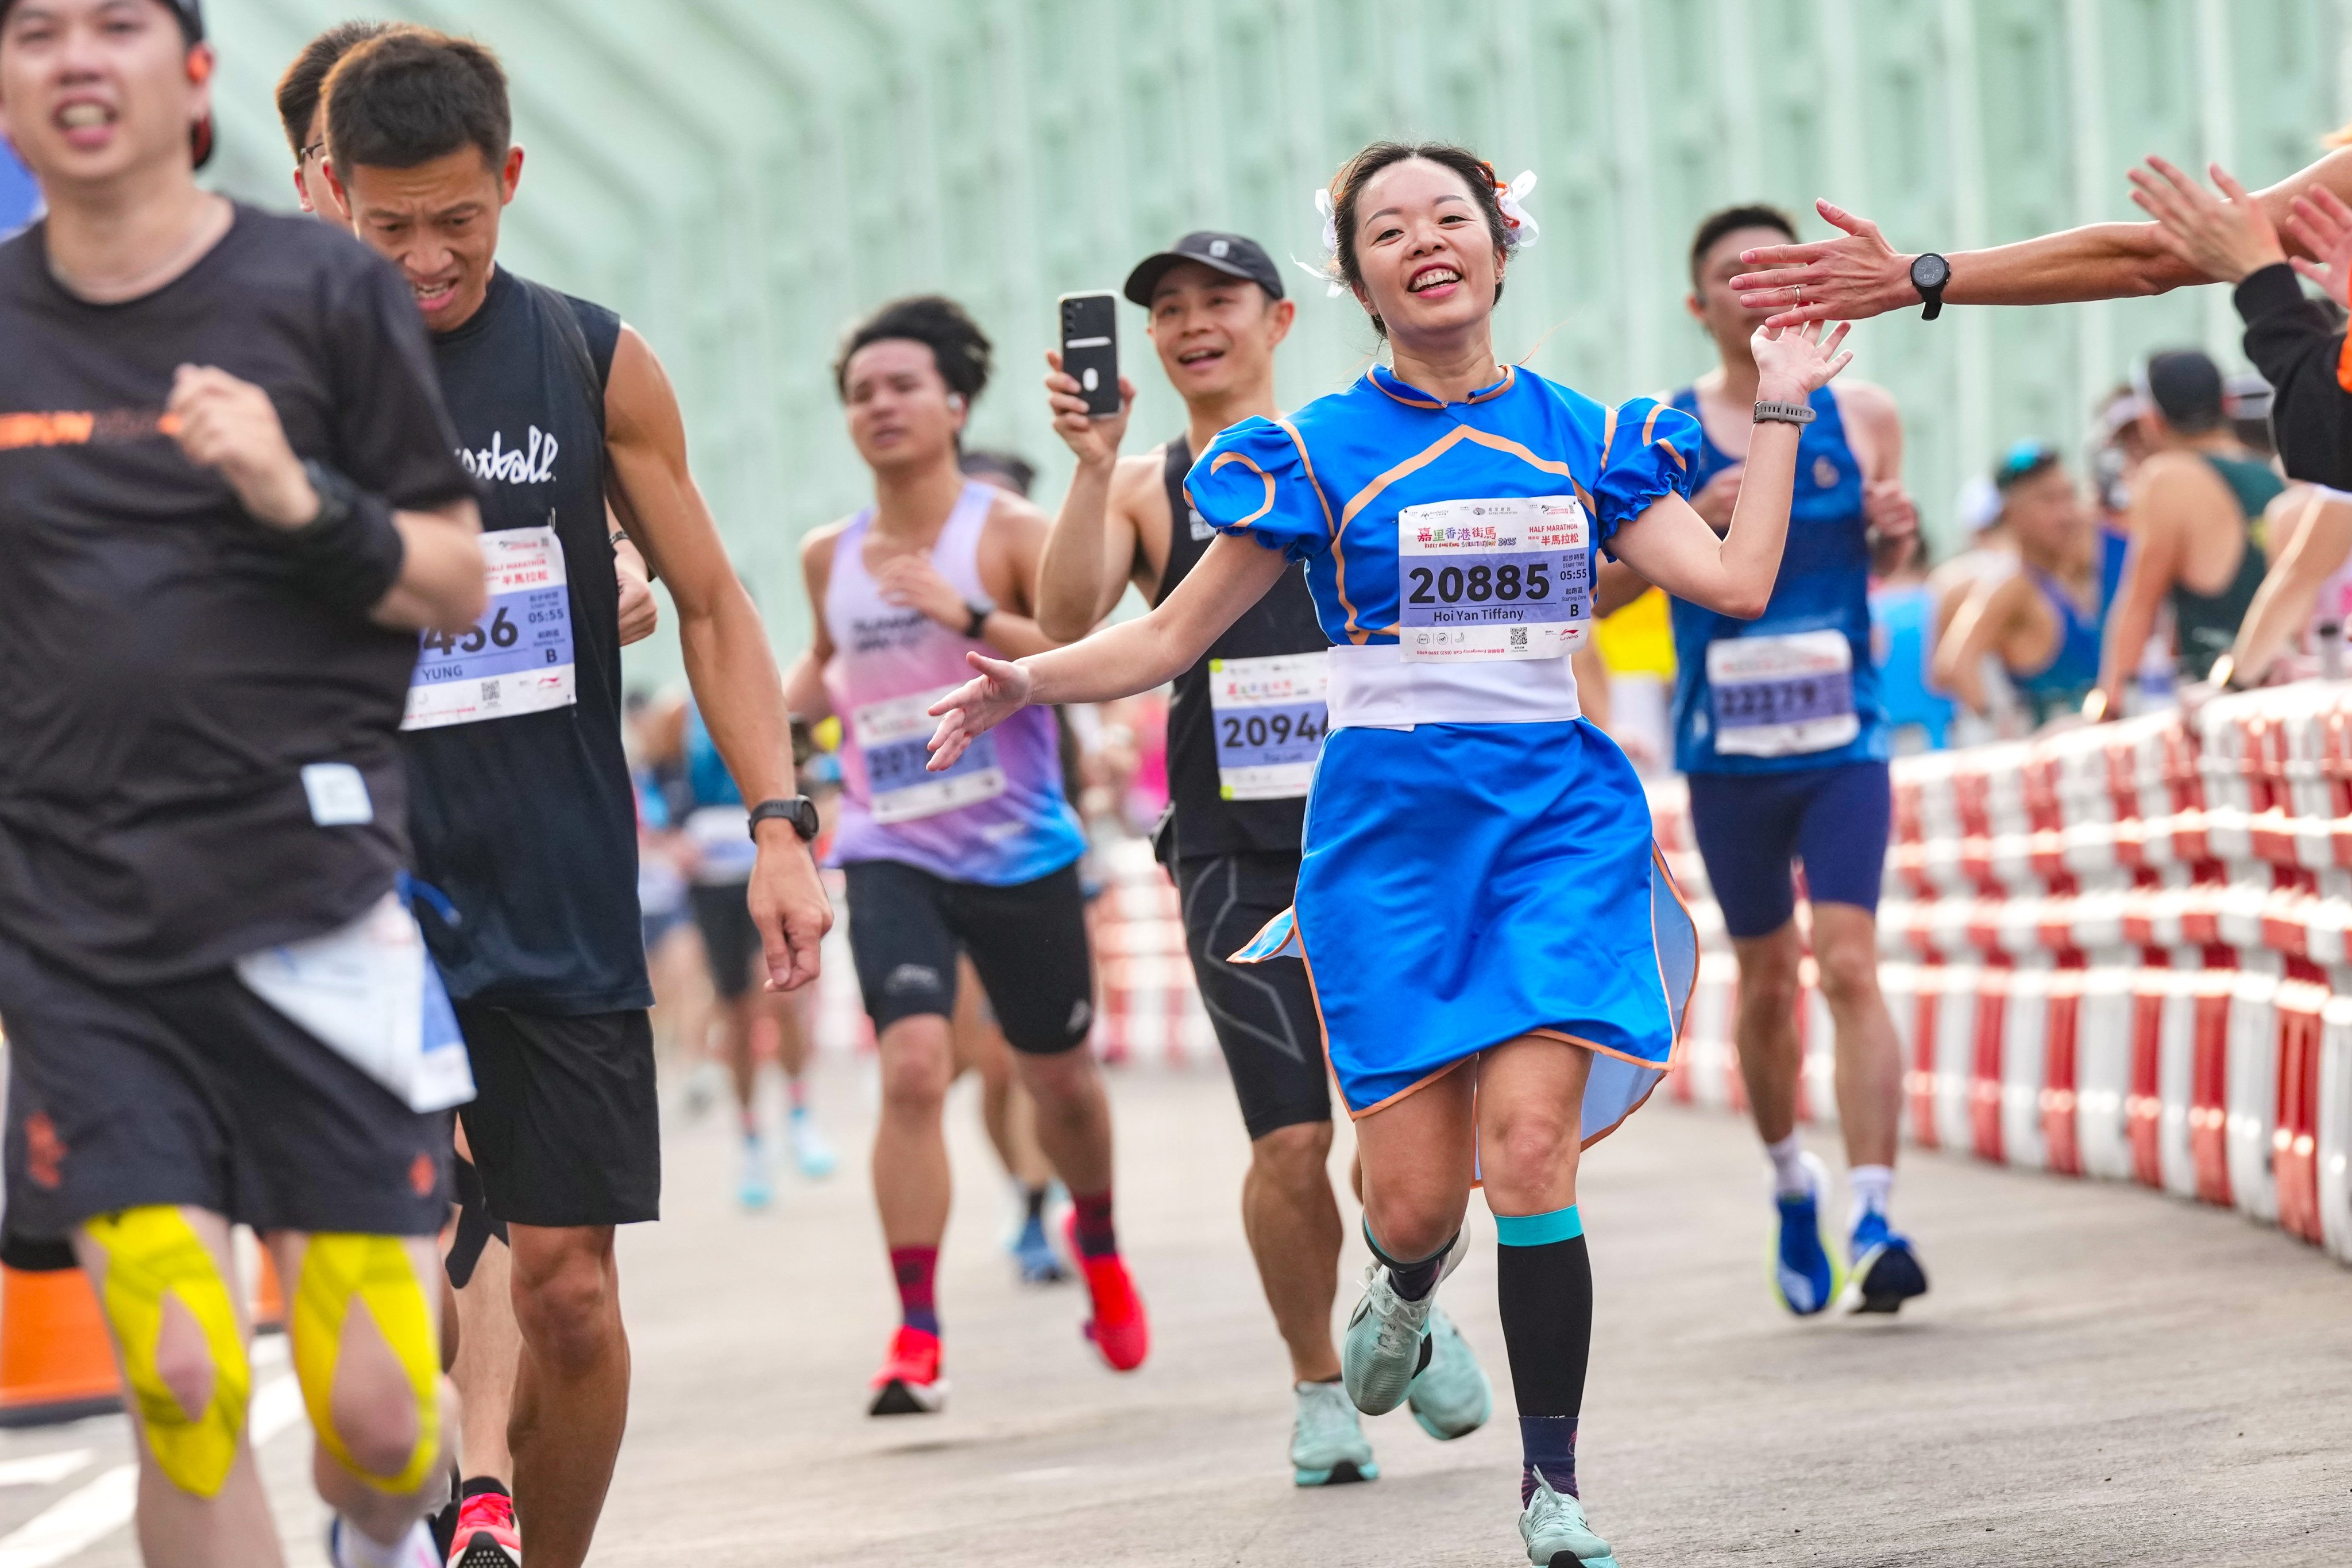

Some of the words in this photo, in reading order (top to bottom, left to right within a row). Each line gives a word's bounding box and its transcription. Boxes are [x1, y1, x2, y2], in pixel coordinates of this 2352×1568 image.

[1417, 526, 1497, 542] 嘉里香港街馬
[1546, 523, 1578, 531] MARATHON
[1497, 537, 1517, 546] 2025
[1541, 532, 1579, 546] 半馬拉松
[1560, 569, 1587, 581] 05:55
[1409, 563, 1550, 604] 20885
[528, 608, 564, 624] 05:55
[1434, 610, 1454, 622] Hoi
[1457, 611, 1478, 621] Yan
[1481, 608, 1524, 621] Tiffany
[1570, 604, 1579, 617] B
[546, 648, 557, 663] B
[422, 665, 463, 680] YUNG
